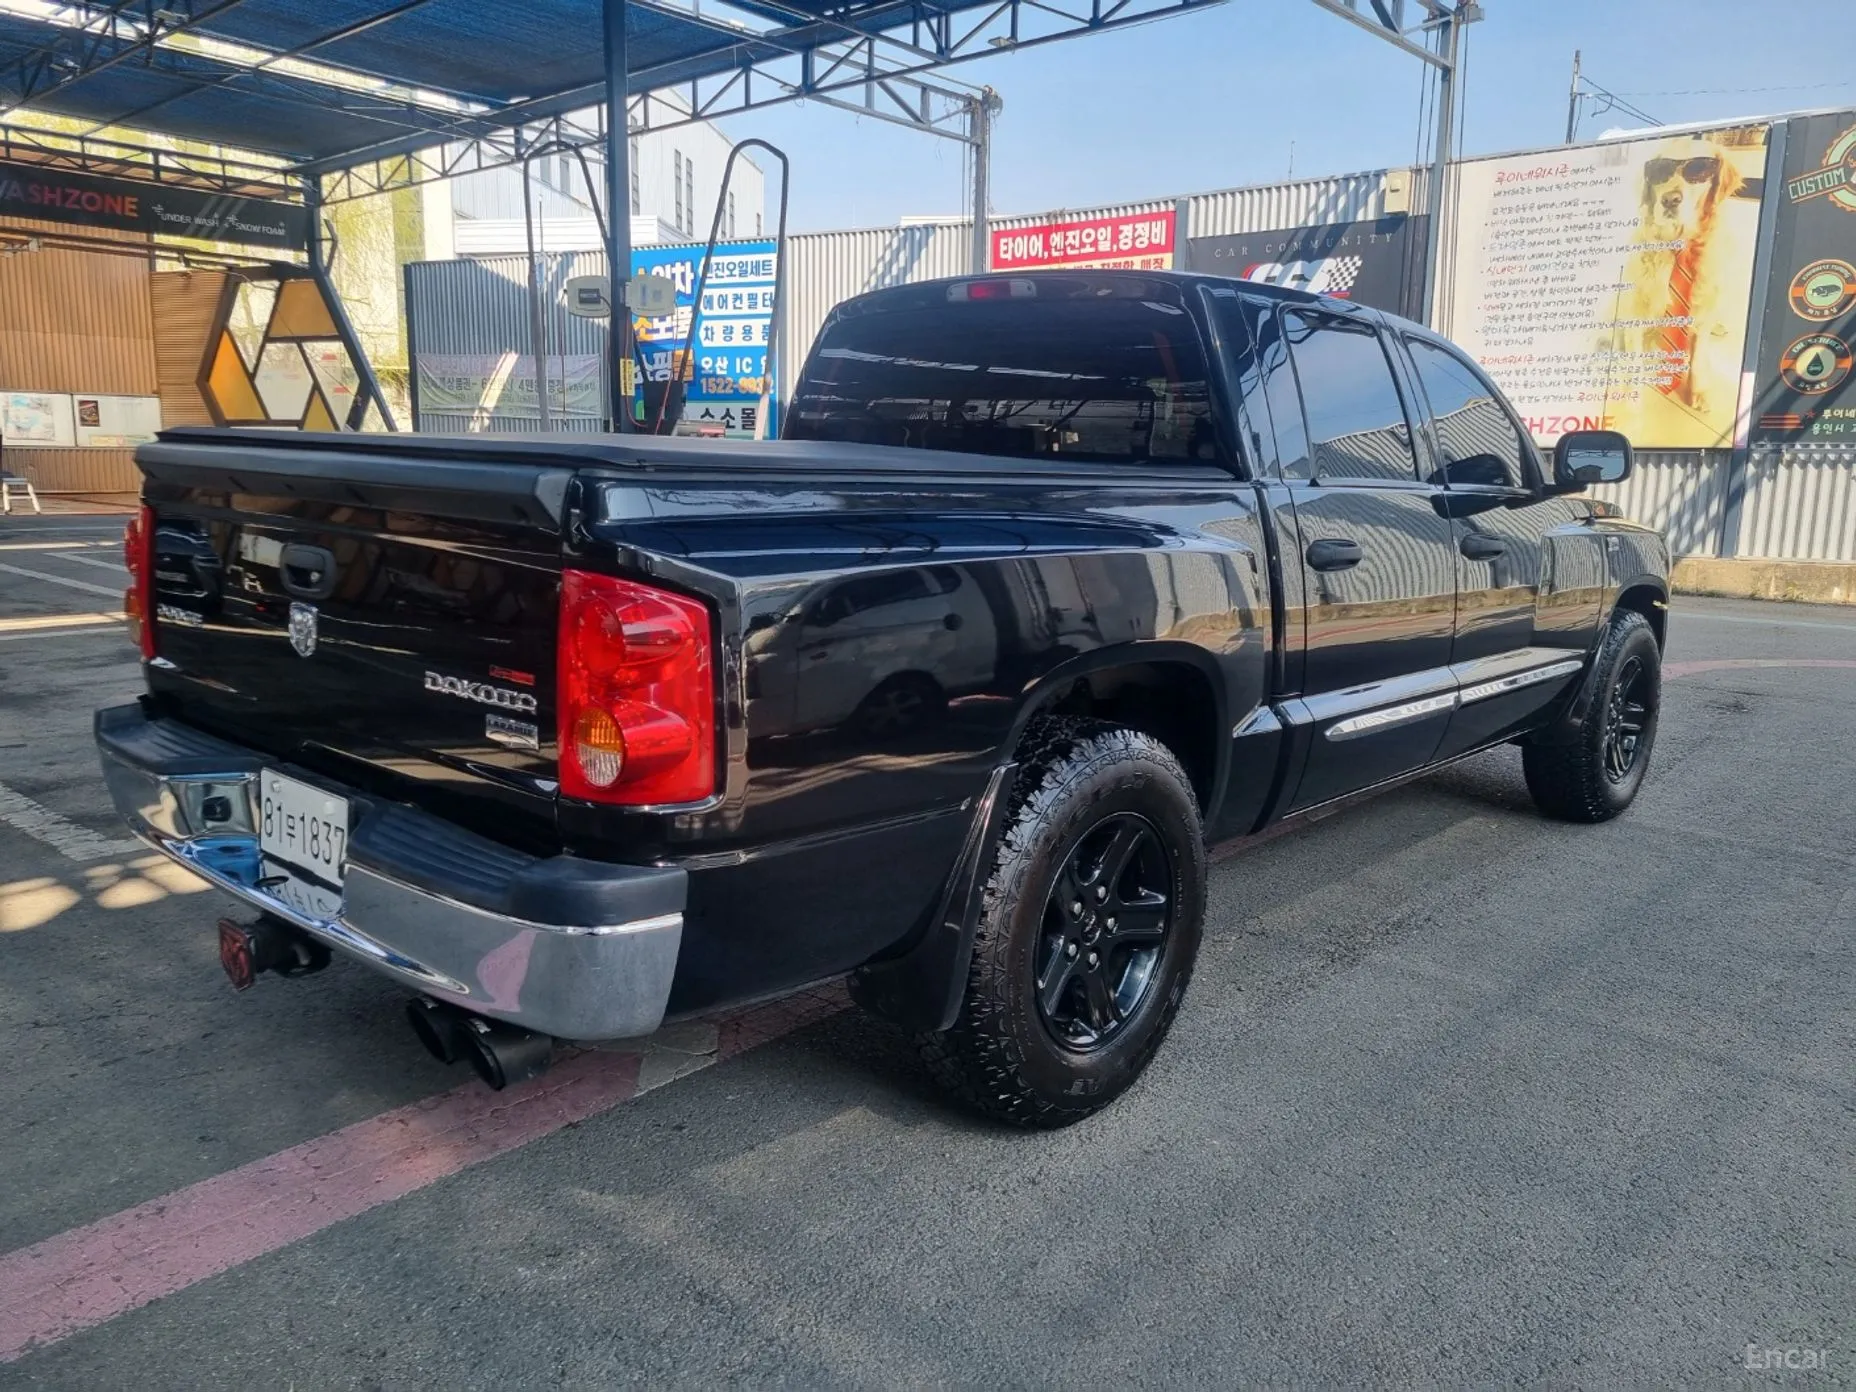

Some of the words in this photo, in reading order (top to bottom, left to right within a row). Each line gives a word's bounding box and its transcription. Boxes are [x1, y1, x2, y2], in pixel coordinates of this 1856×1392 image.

[1788, 167, 1847, 199] CUSTOM
[0, 179, 139, 217] ASHZONE
[161, 213, 192, 225] UNDER
[194, 217, 220, 228] WASH
[235, 222, 261, 233] SNOW
[262, 225, 286, 236] FOAM
[1214, 247, 1249, 258] CAR
[1265, 233, 1393, 253] COMMUNITY
[703, 291, 774, 311] 에어컨필터
[701, 356, 728, 375] 오산
[736, 357, 753, 374] IC
[424, 671, 537, 715] DAKOTA
[264, 797, 345, 866] 81무1837
